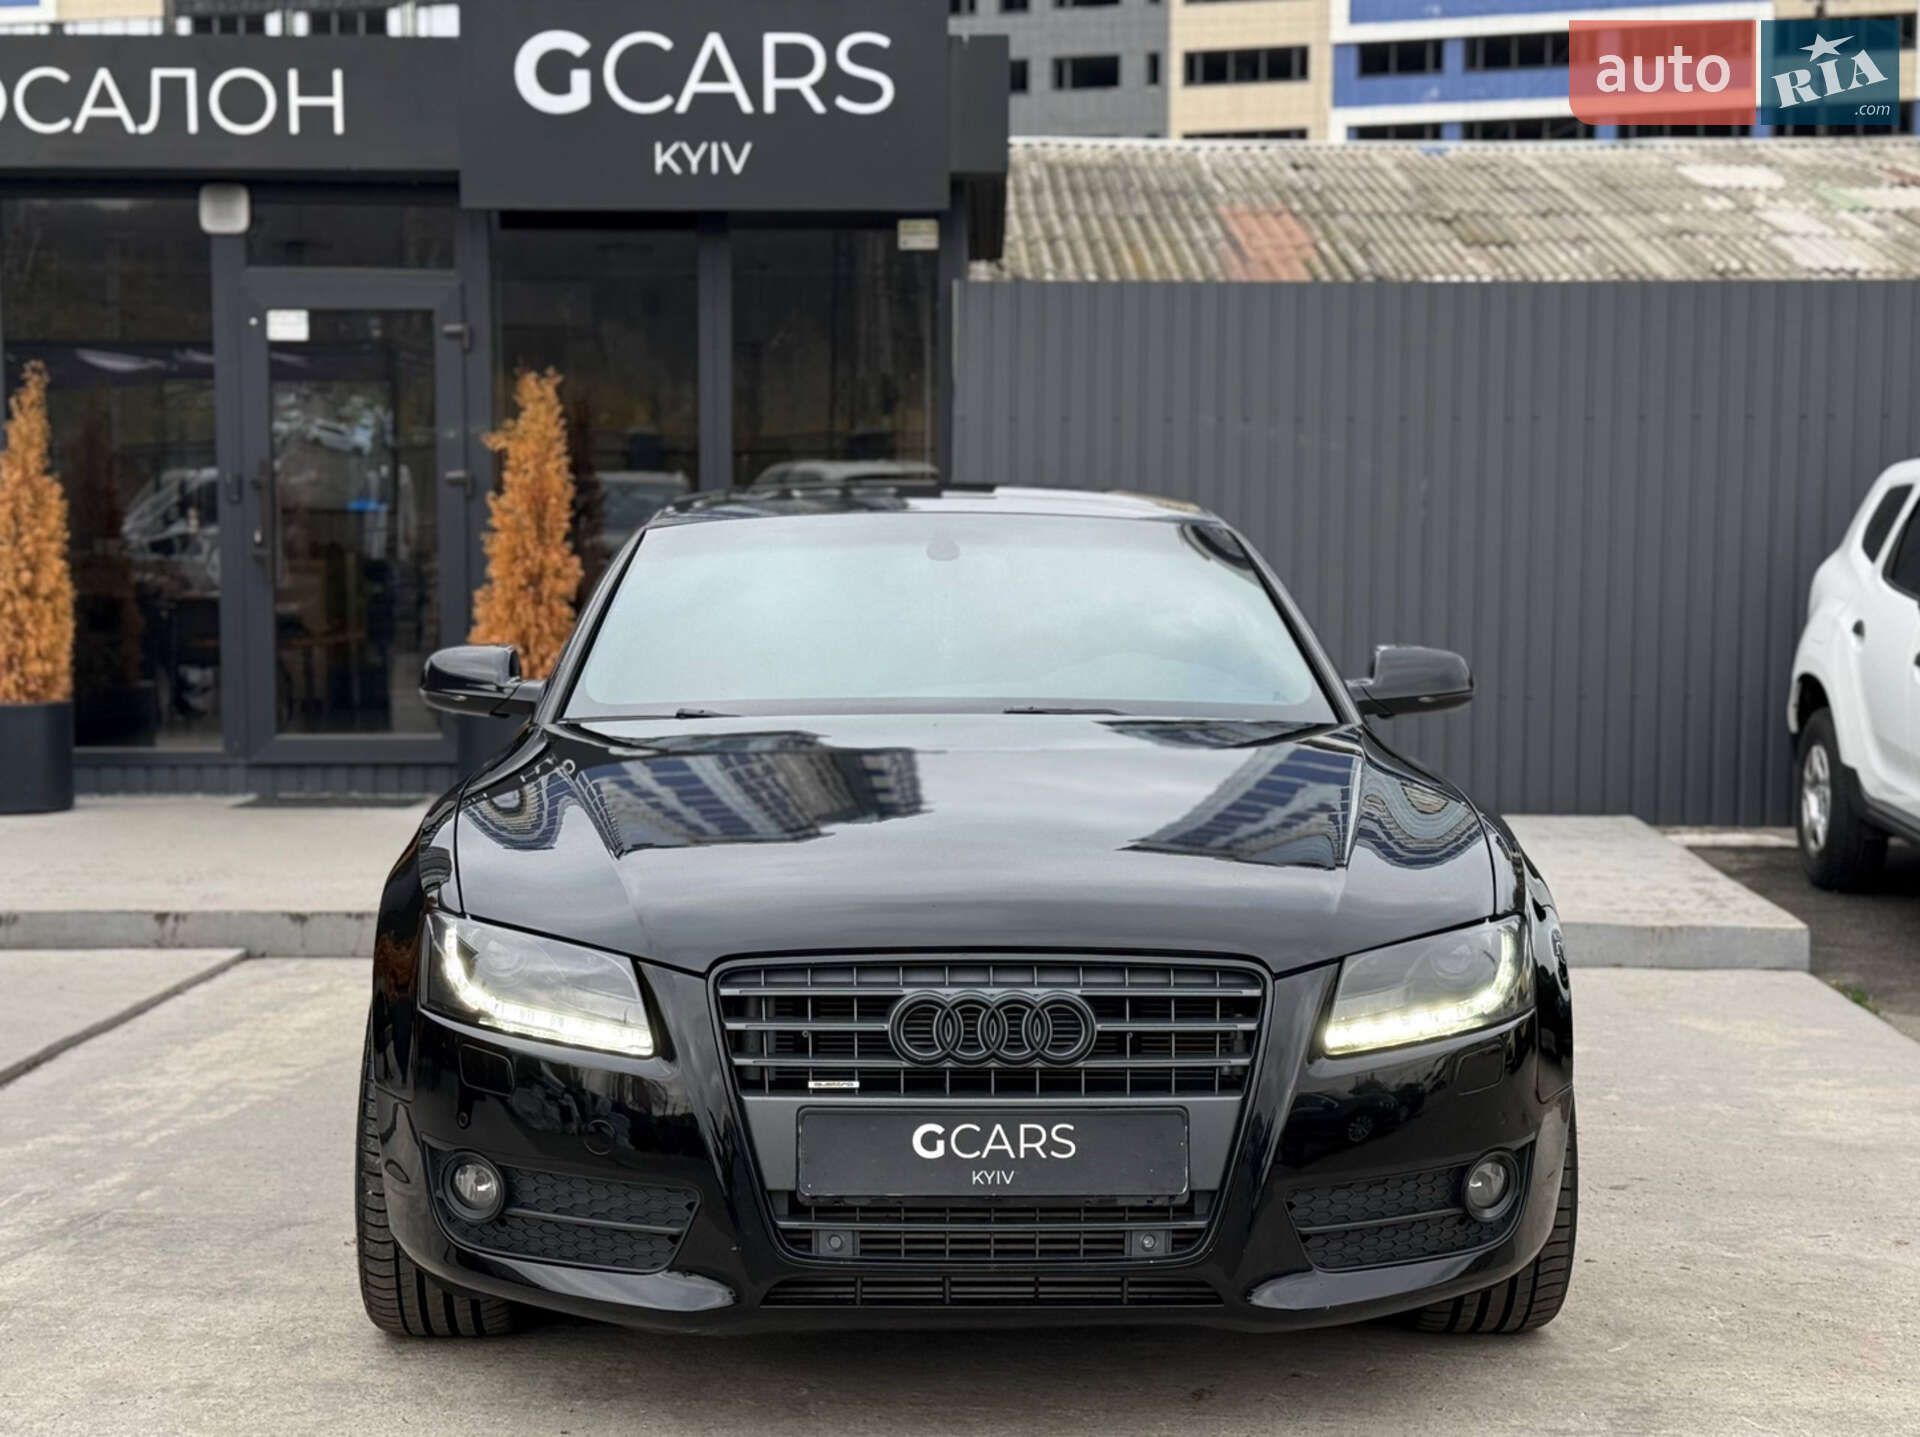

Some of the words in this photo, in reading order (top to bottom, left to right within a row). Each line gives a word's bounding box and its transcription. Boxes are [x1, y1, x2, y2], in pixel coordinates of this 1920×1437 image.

[513, 29, 895, 115] GCARS
[0, 66, 345, 135] САЛОН
[654, 141, 752, 175] KYIV
[911, 1122, 1077, 1160] GCARS
[971, 1169, 1015, 1185] KYIV
